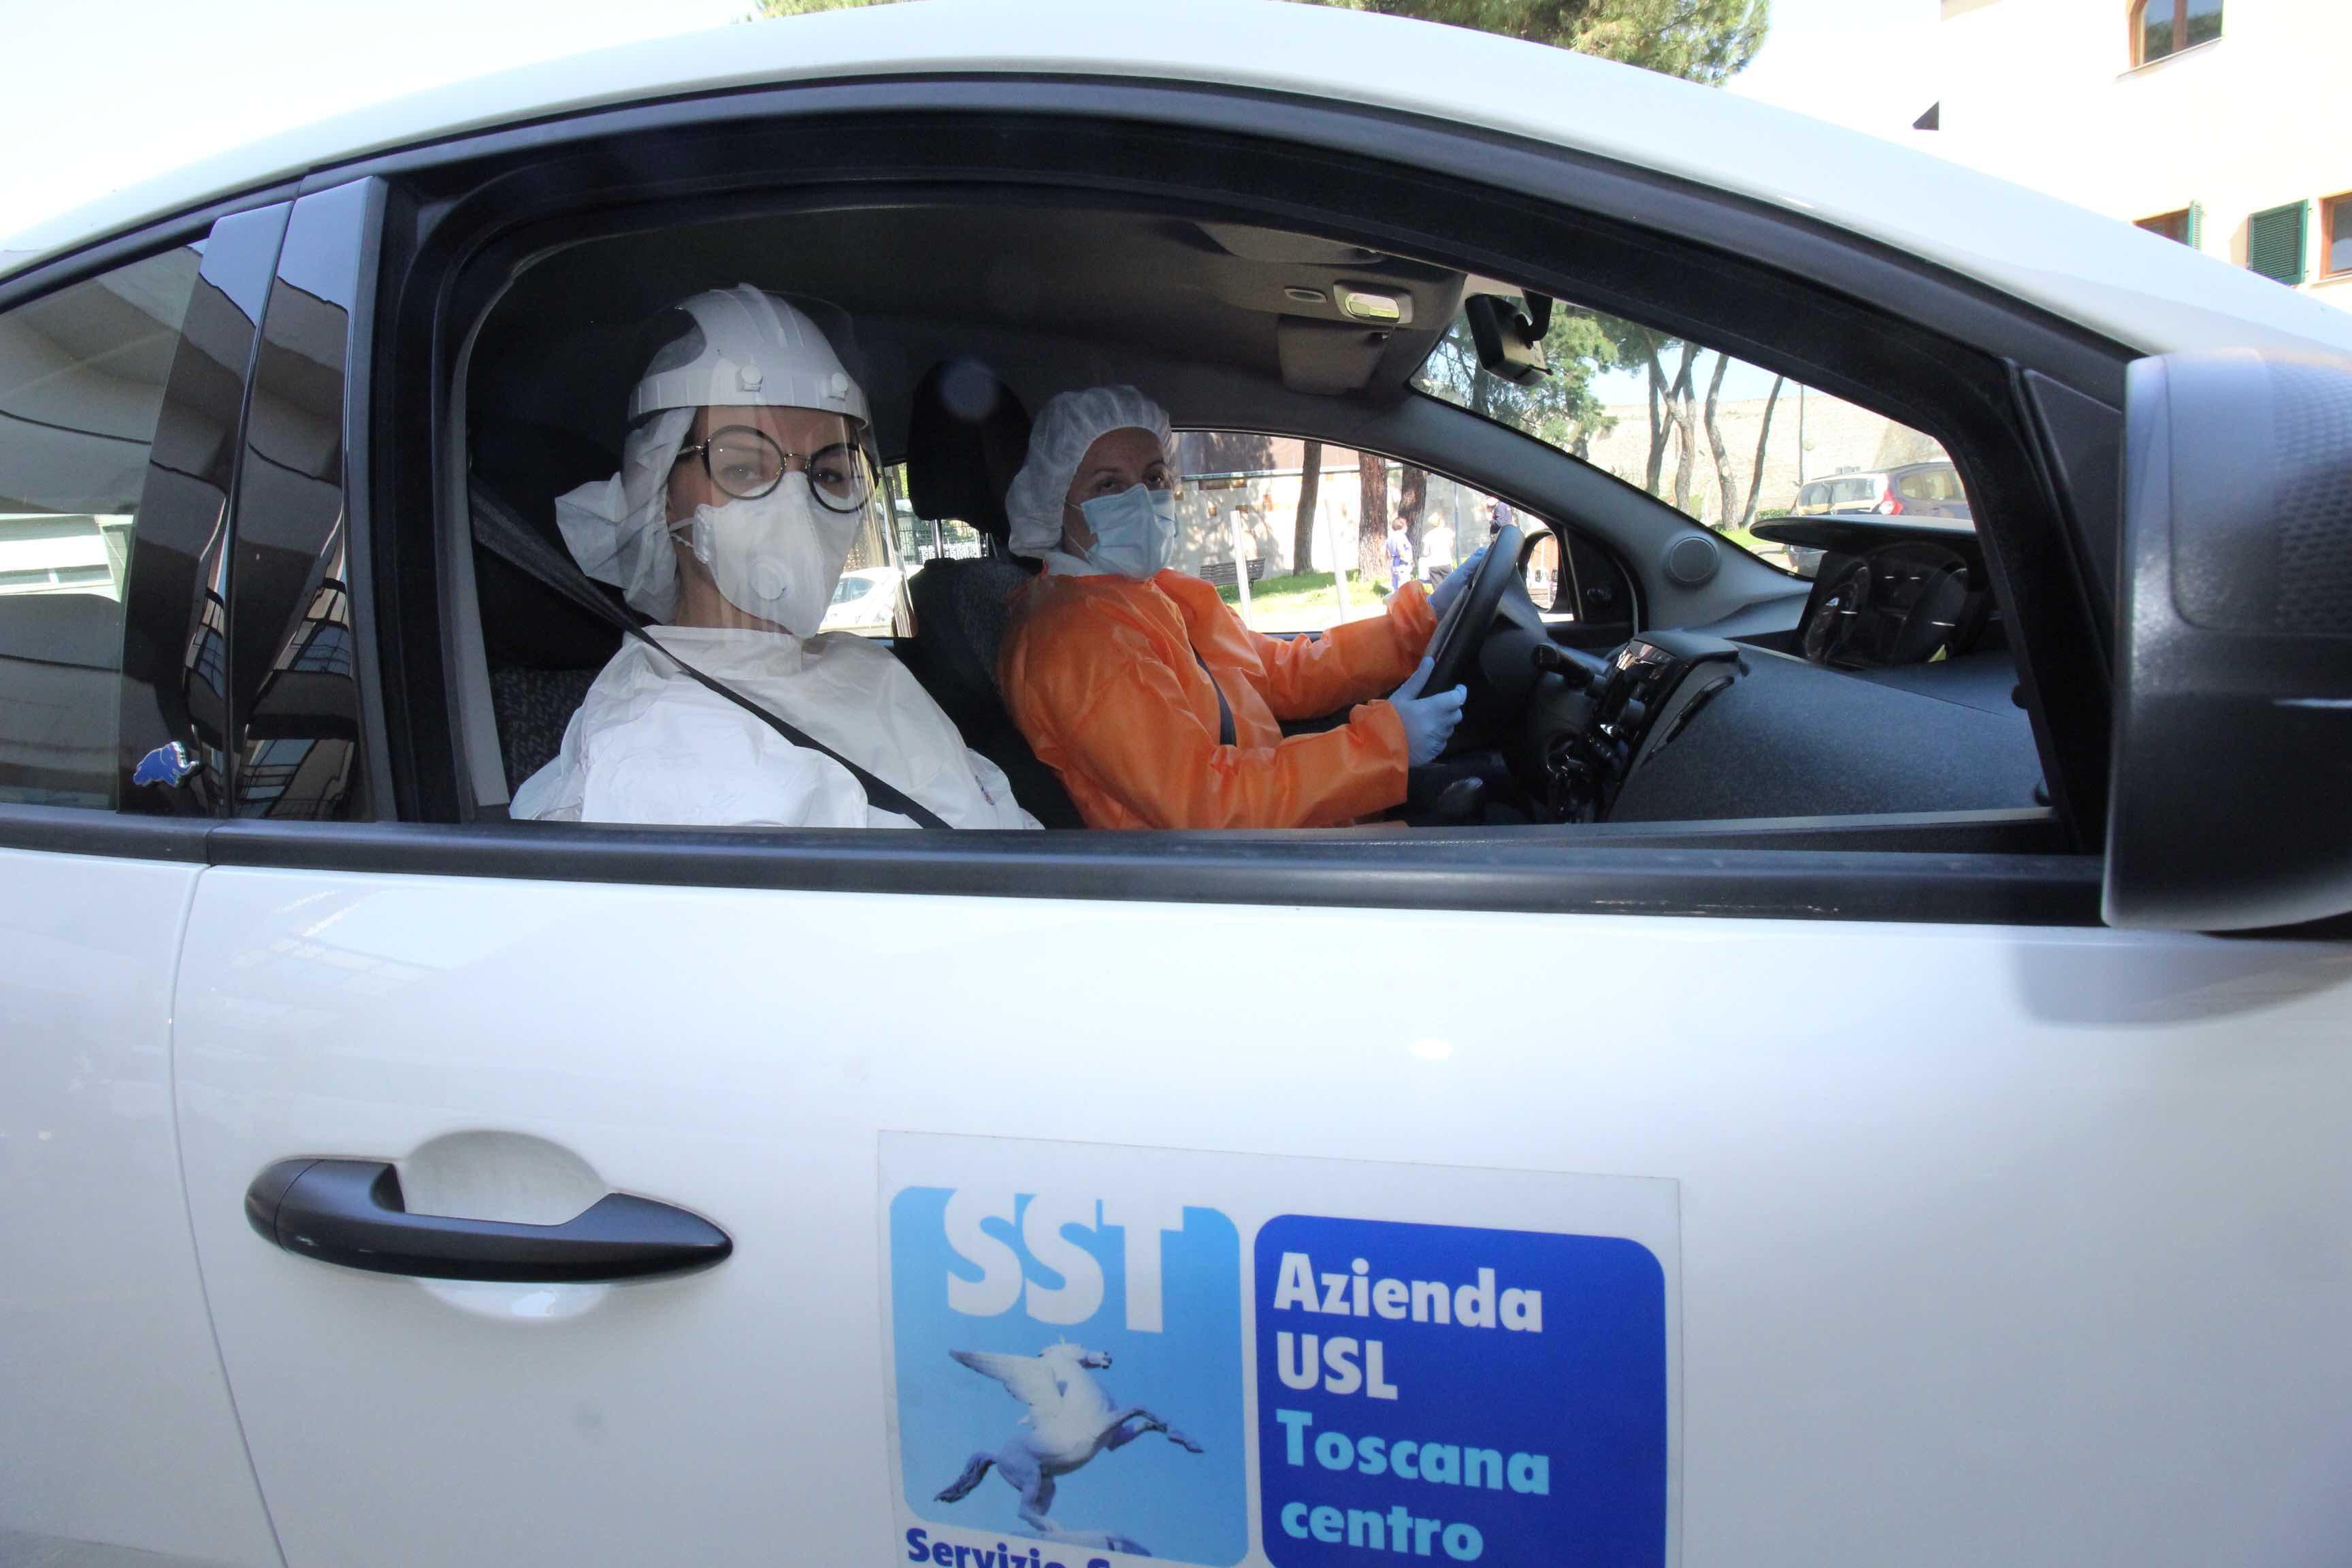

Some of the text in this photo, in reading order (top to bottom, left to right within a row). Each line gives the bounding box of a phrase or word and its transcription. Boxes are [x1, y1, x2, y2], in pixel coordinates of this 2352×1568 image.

[943, 1188, 1183, 1334] SST
[1273, 1252, 1543, 1333] Azienda
[1276, 1331, 1399, 1401] USL
[1276, 1408, 1550, 1495] Toscana
[906, 1527, 1067, 1568] Servizi
[1281, 1502, 1484, 1562] centro
